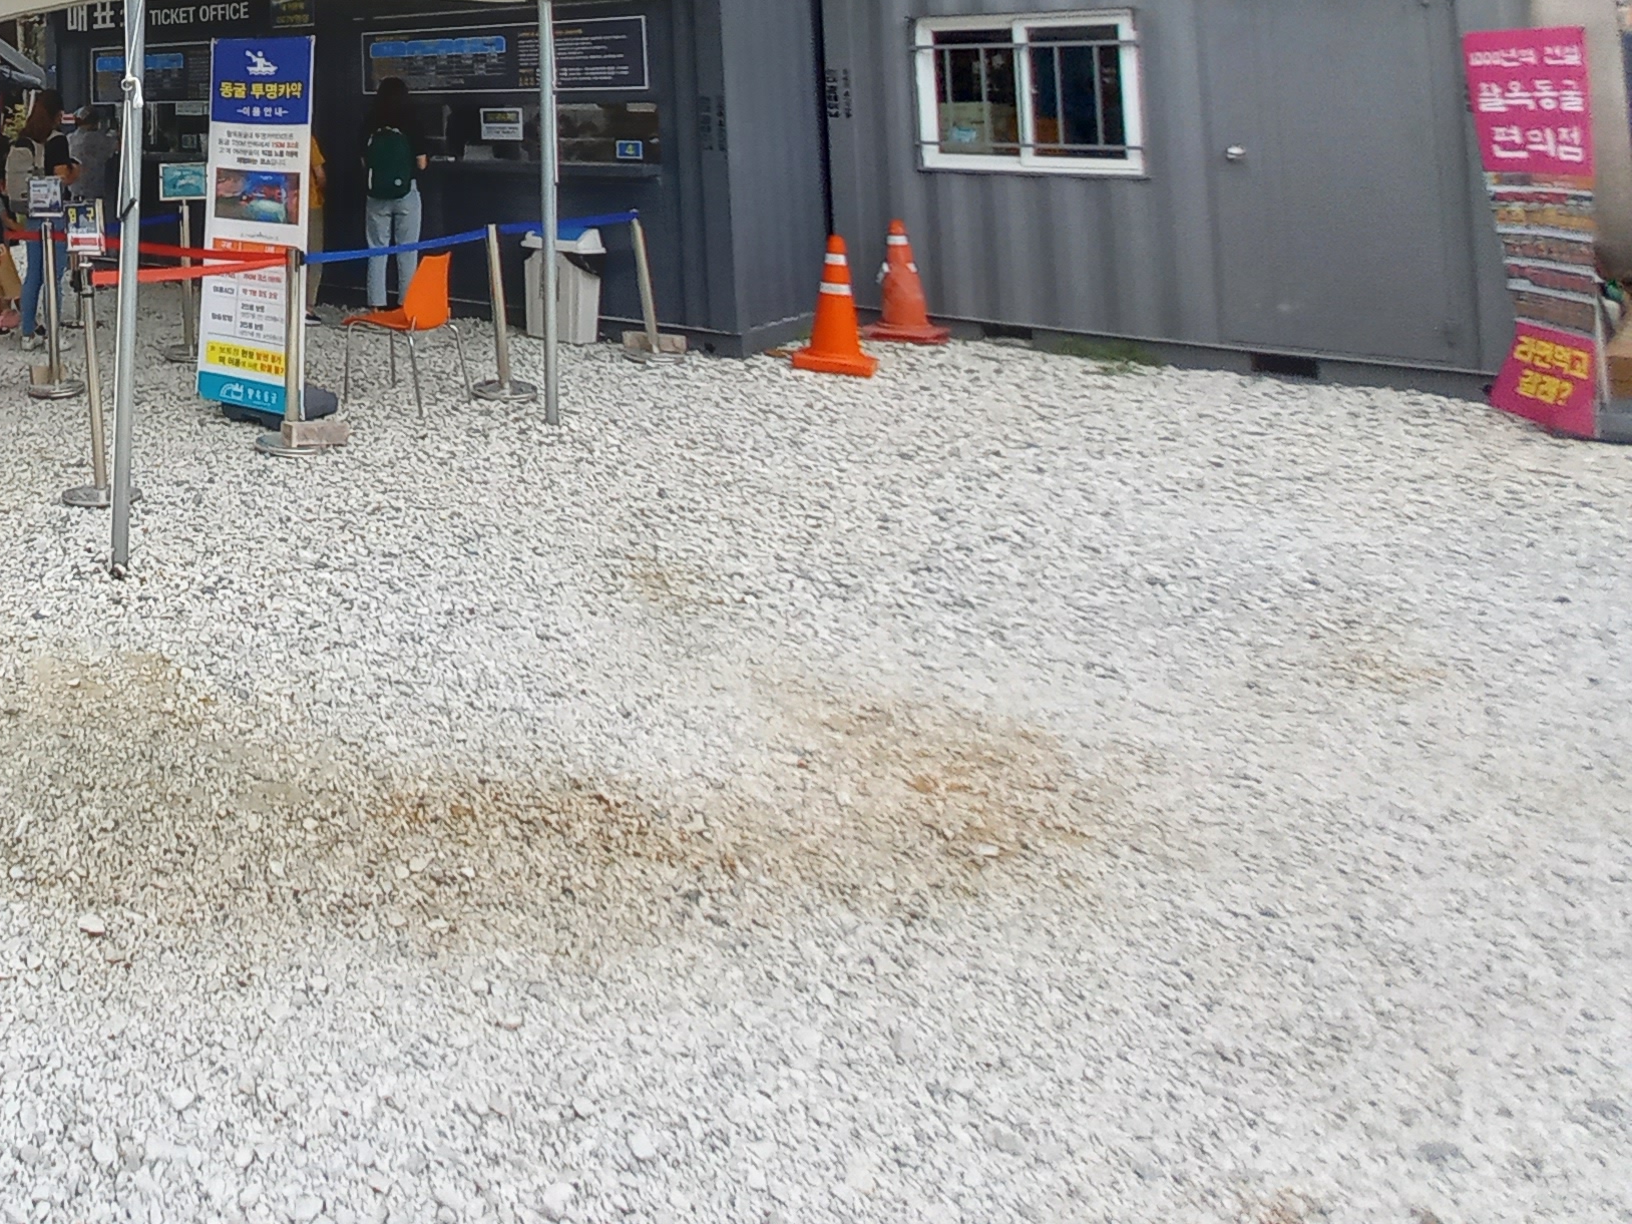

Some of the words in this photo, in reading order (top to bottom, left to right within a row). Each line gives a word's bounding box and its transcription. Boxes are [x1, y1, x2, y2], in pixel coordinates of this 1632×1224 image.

[67, 1, 125, 32] 매표
[149, 6, 196, 26] TICKET
[199, 1, 249, 22] OFFICE
[219, 81, 246, 98] 동굴
[250, 81, 302, 99] 투명카약
[625, 144, 635, 155] 4
[1491, 126, 1584, 163] 편의점
